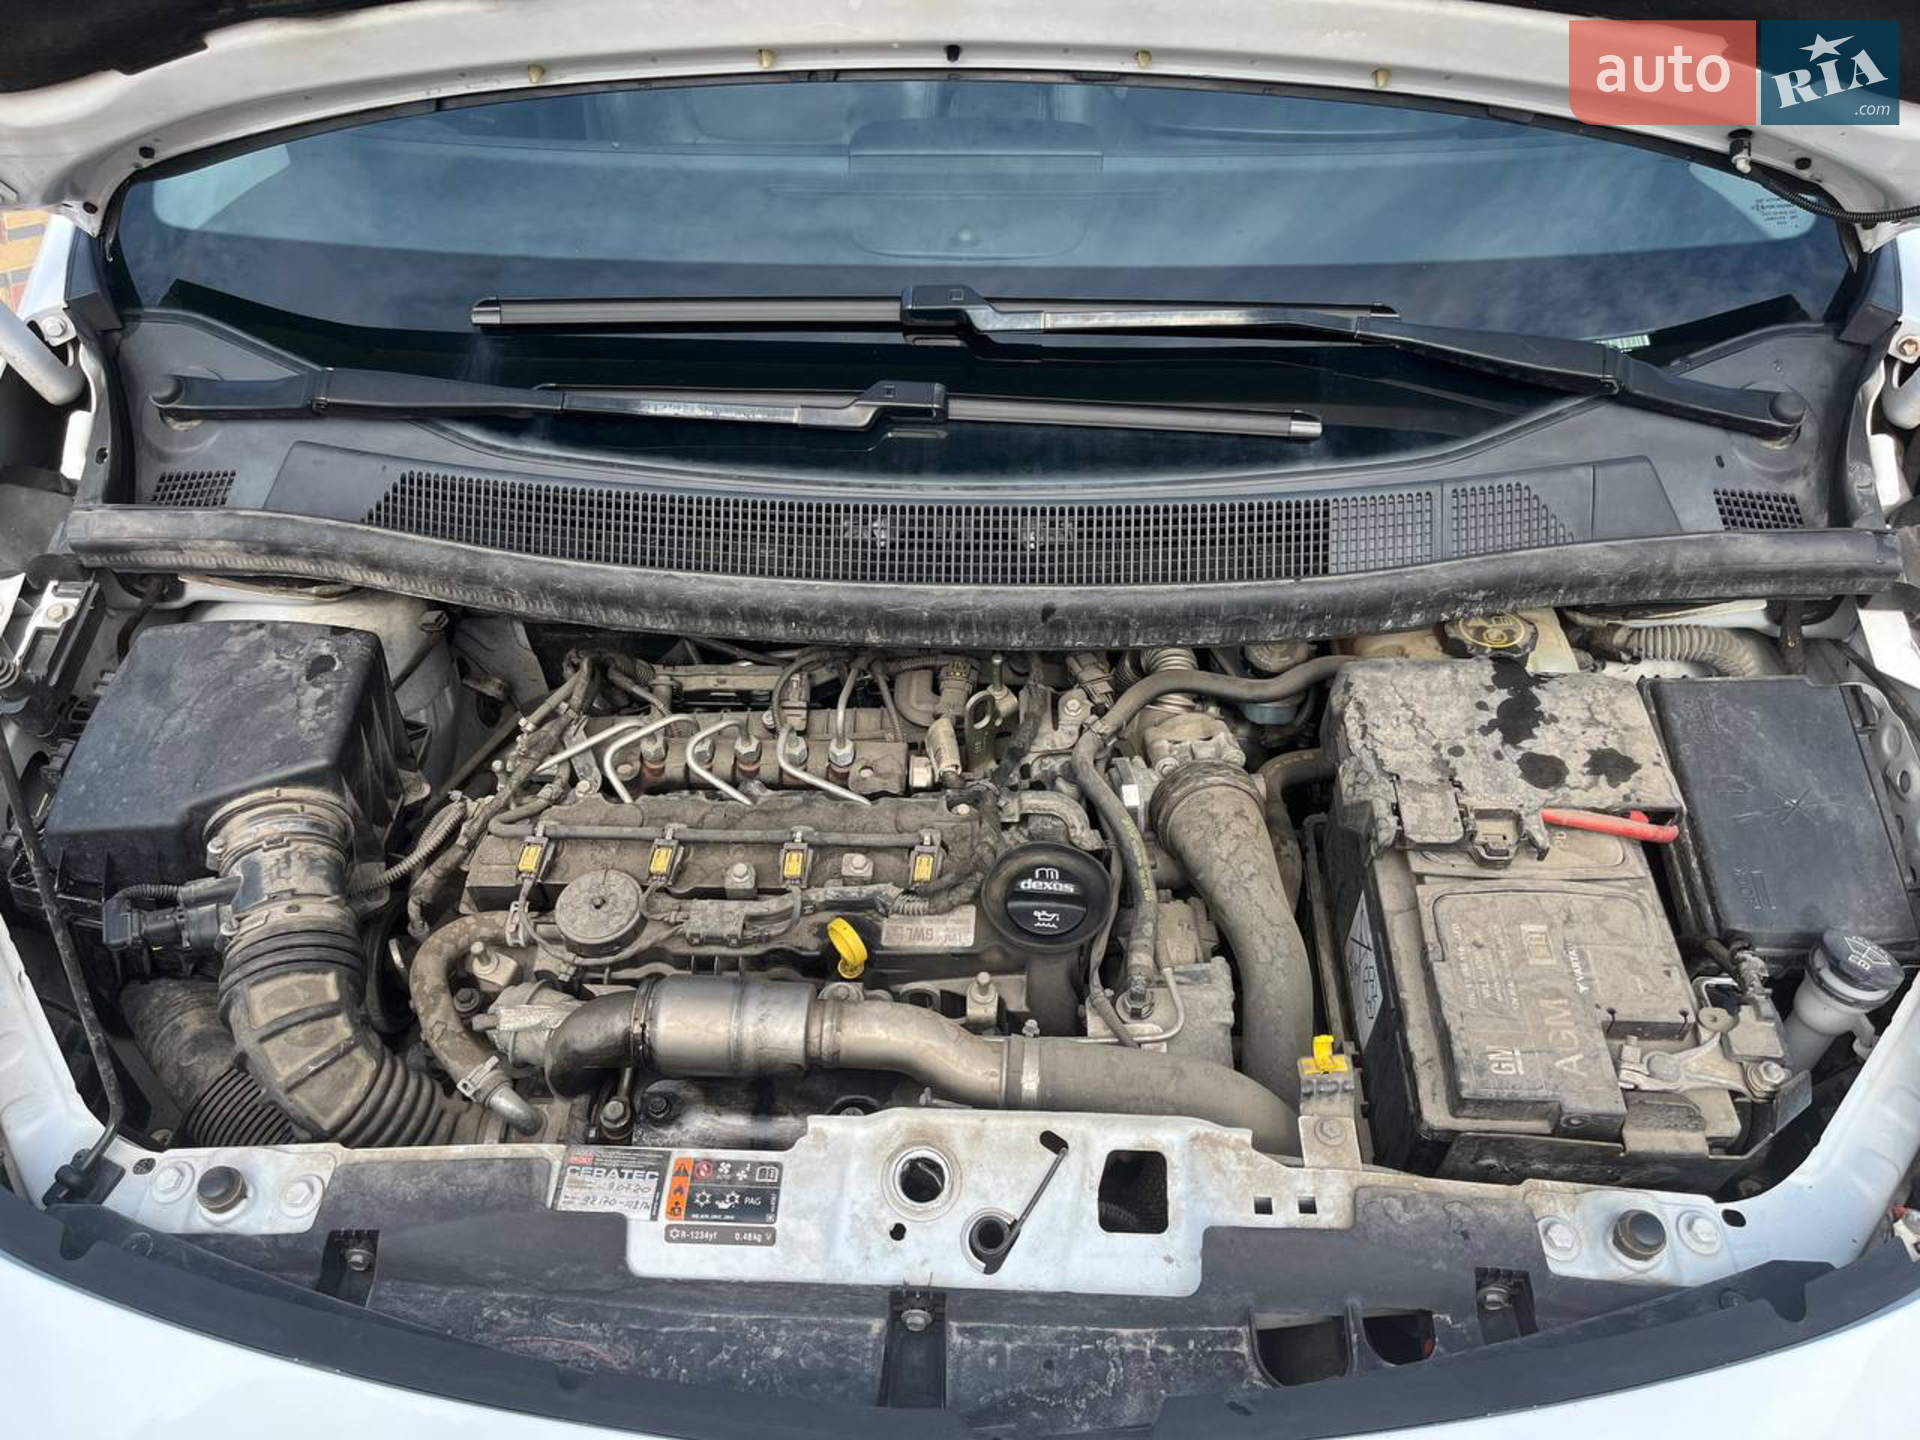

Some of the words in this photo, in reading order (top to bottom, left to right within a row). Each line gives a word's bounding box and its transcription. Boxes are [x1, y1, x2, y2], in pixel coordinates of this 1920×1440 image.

[1020, 878, 1076, 893] dexos
[1567, 949, 1585, 982] VARTA
[1538, 998, 1589, 1077] AGM
[1486, 1045, 1517, 1075] GM
[744, 1197, 762, 1206] PAG
[680, 1230, 718, 1241] R-1234yf
